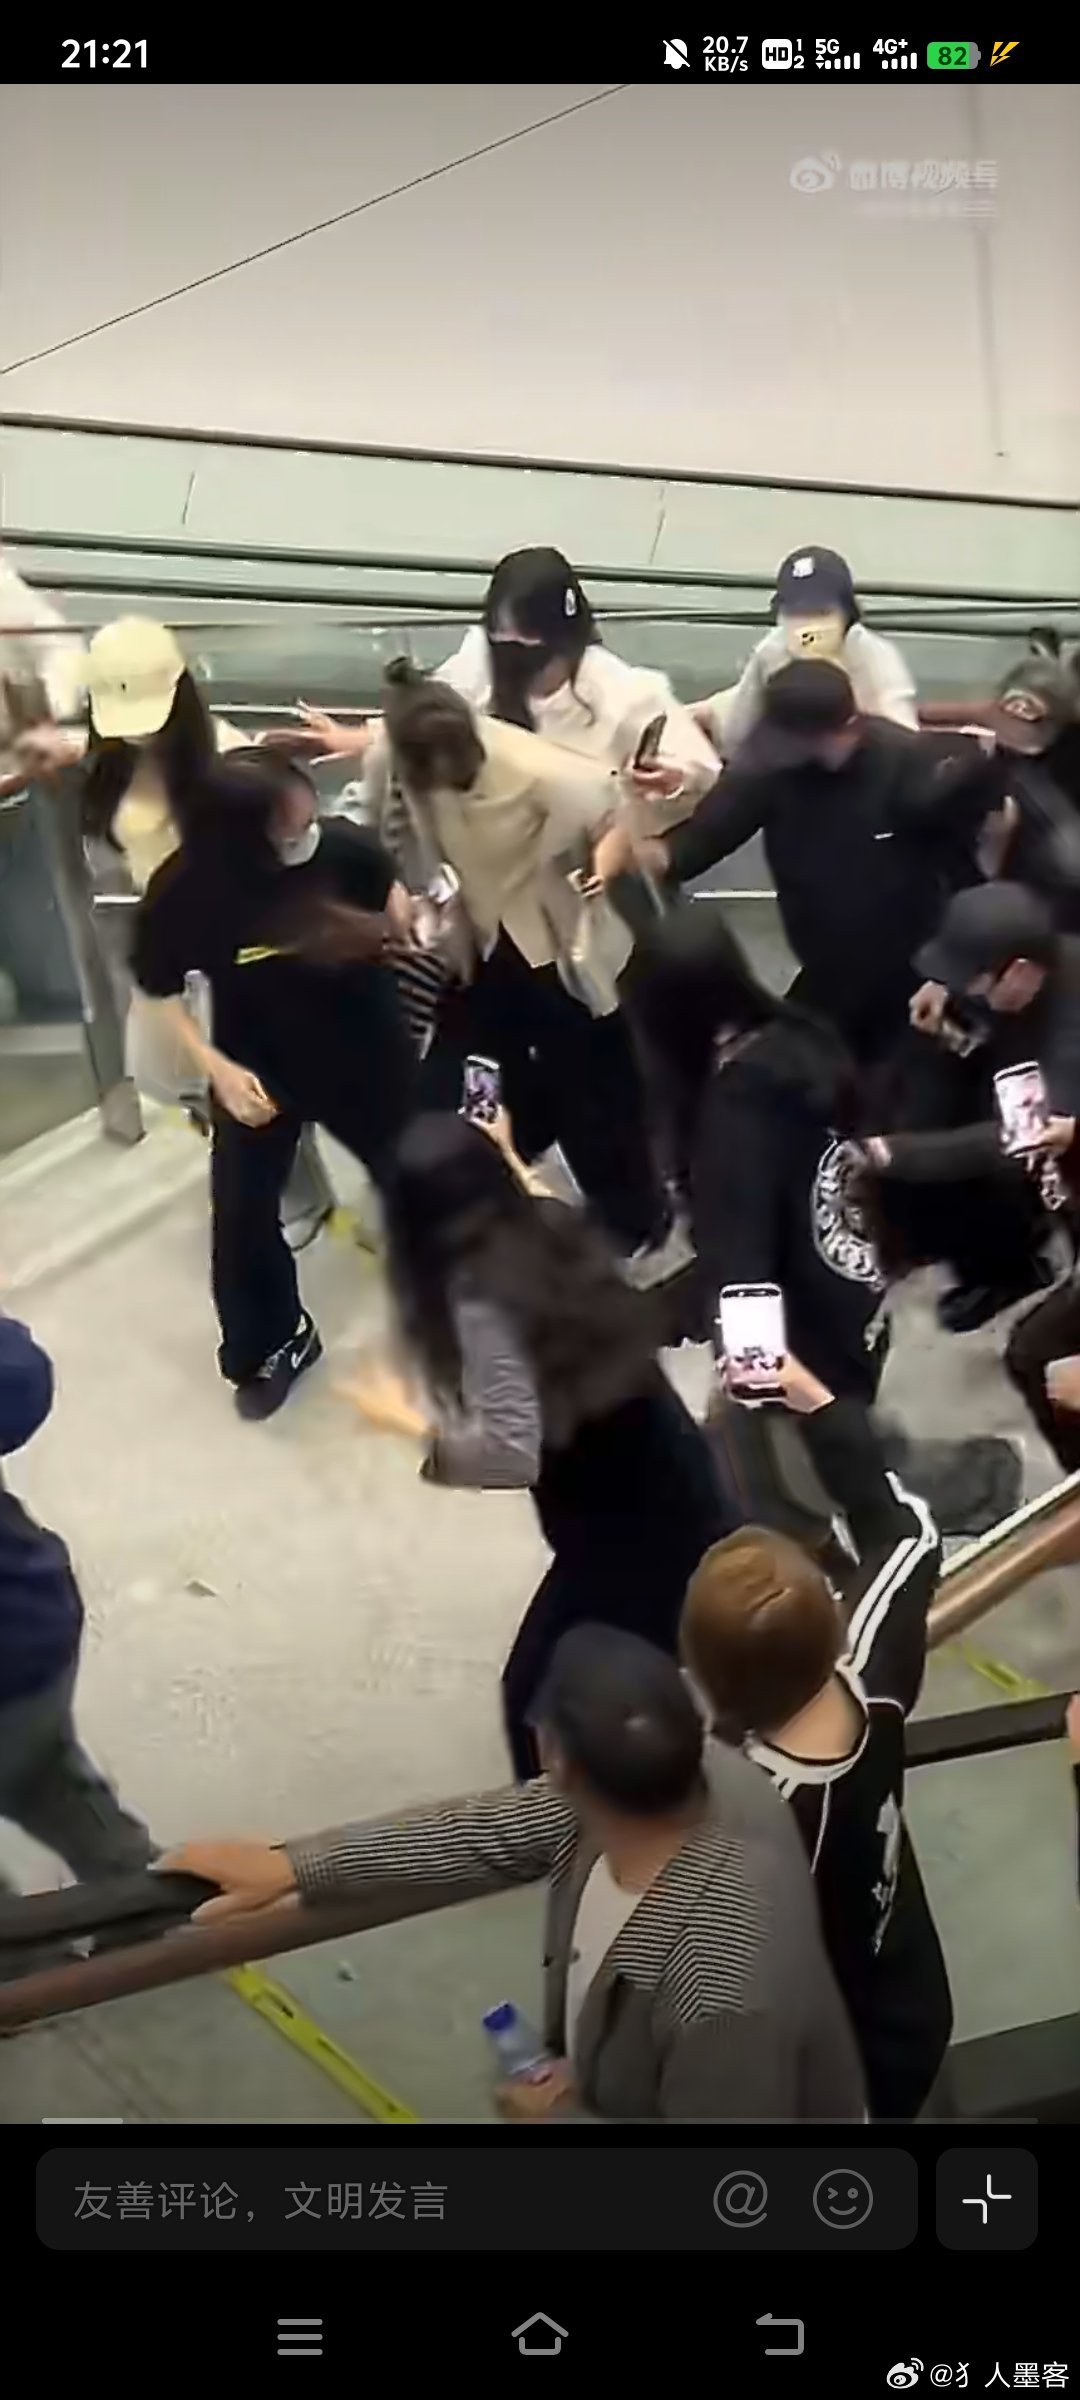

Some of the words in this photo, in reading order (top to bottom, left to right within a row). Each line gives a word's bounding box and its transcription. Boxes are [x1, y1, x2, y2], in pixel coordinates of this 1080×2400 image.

[702, 35, 749, 54] 20.7
[815, 38, 840, 54] 5G
[872, 38, 909, 55] 4G+
[61, 38, 147, 69] 21:21
[765, 46, 788, 62] HD
[793, 54, 805, 69] 2
[938, 46, 967, 66] 82
[704, 56, 749, 73] KB/s
[74, 2180, 448, 2223] 友善评论，文明发言
